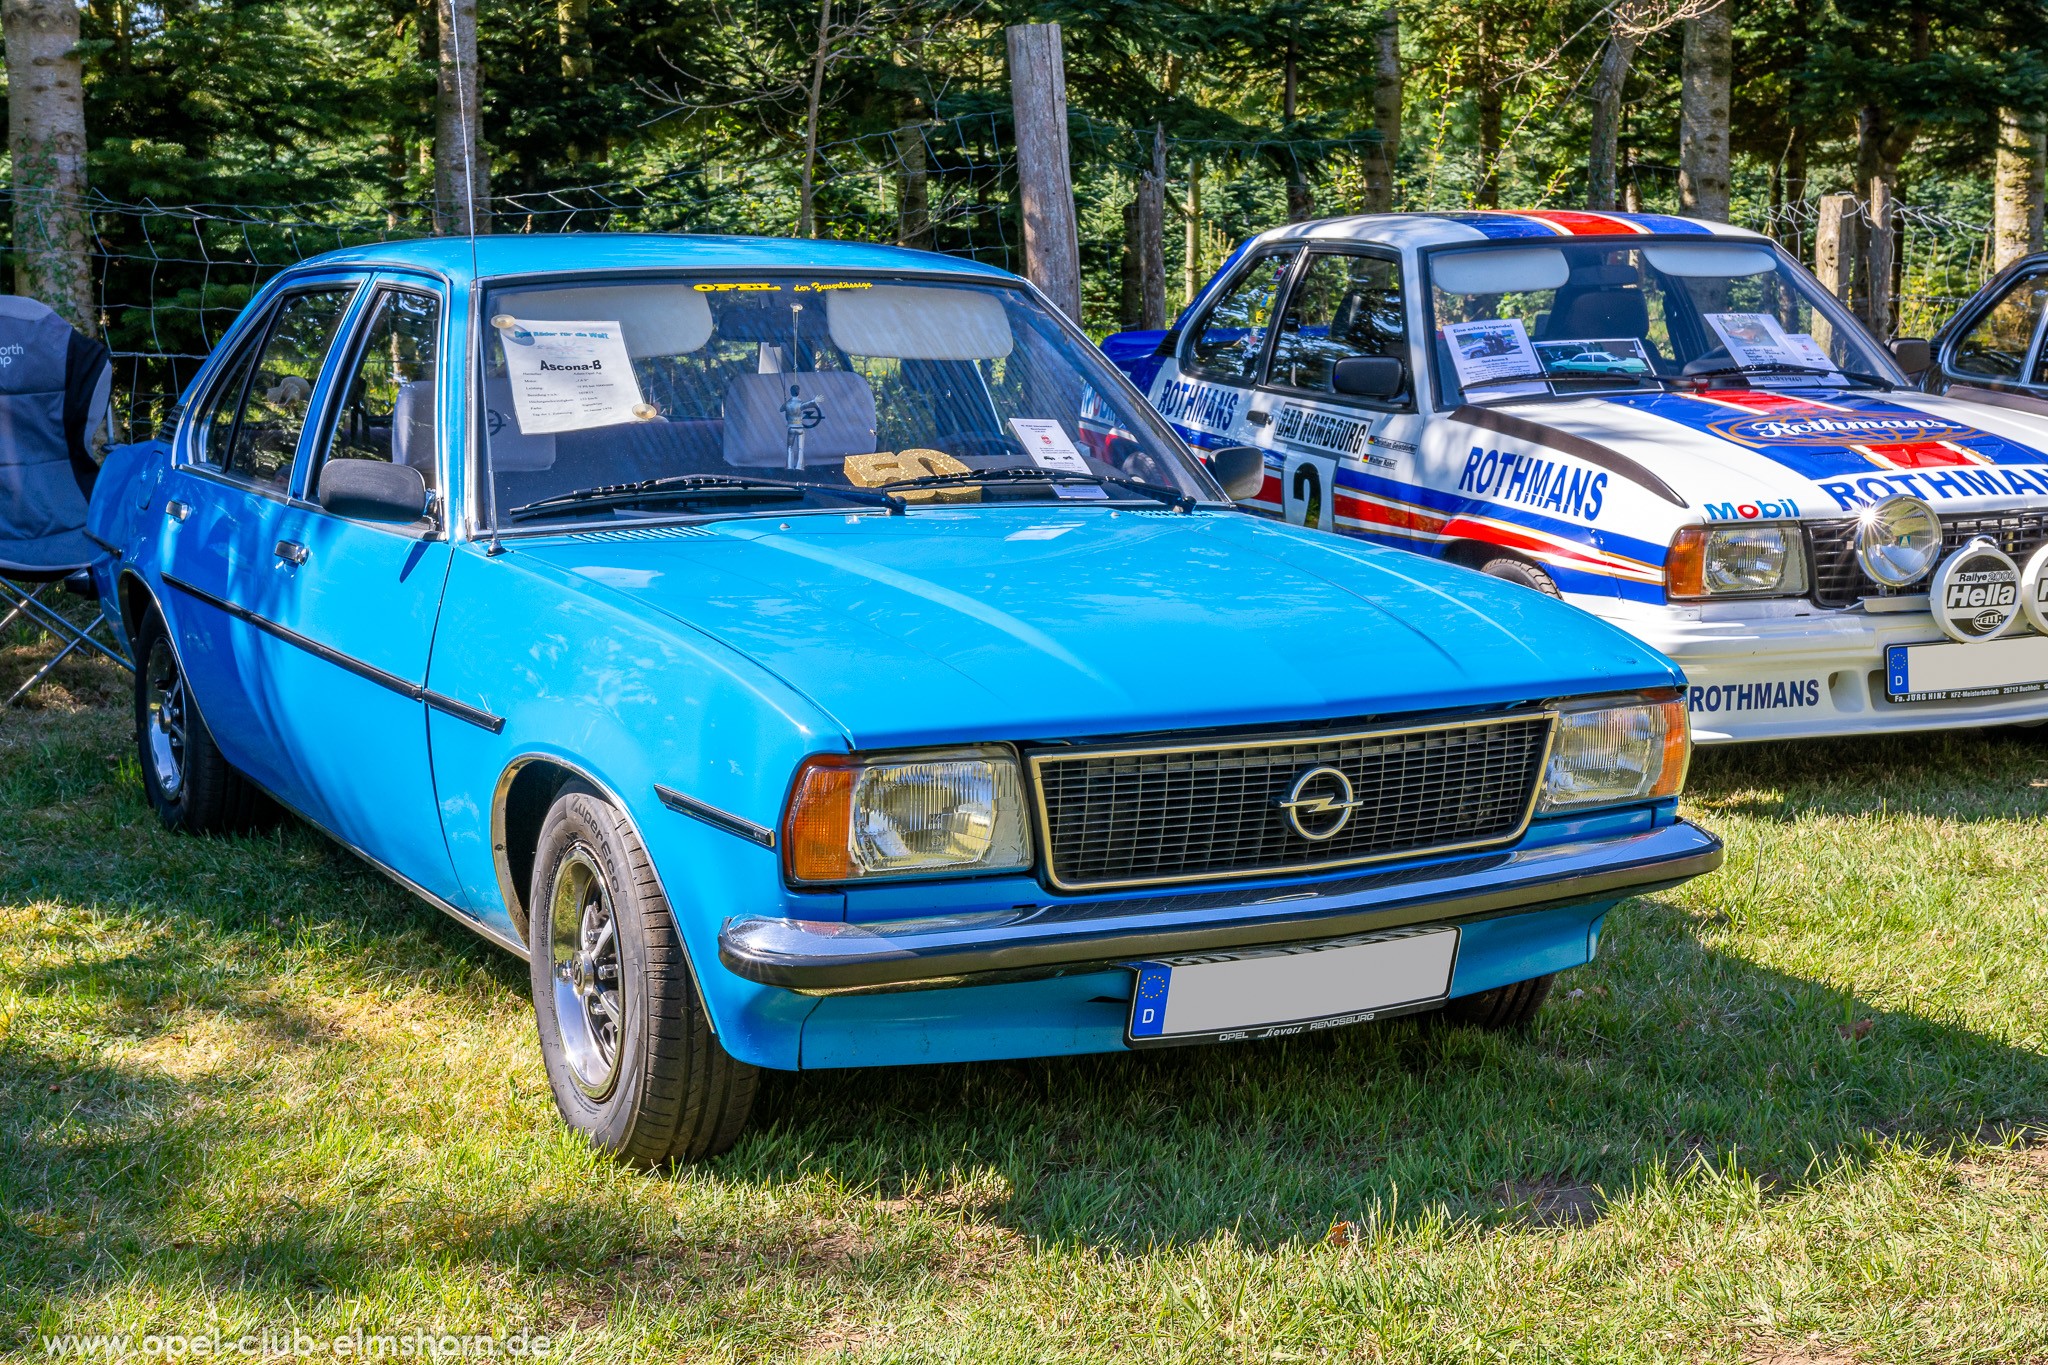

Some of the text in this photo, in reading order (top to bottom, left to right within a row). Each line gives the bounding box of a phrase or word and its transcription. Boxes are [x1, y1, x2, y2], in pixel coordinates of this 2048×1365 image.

[693, 283, 781, 292] OPEL
[540, 359, 602, 371] Ascona-B
[1158, 379, 1239, 431] ROTHMANS
[1277, 408, 1367, 454] BAD HOMBOURG
[1751, 418, 1962, 437] Rothmans
[1369, 456, 1383, 464] Walter
[1458, 446, 1608, 522] ROTHMANS
[1703, 499, 1800, 520] Mobil
[1959, 570, 2016, 583] Rallye 2000
[1947, 583, 2015, 608] Hella
[1975, 614, 2003, 624] HELLA
[1895, 675, 1903, 686] D
[1689, 679, 1819, 712] ROTHMANS
[1894, 695, 1905, 703] Fa.
[1928, 692, 1947, 700] HINZ
[1951, 688, 2000, 698] KFZ-Meisterbetrieb
[2019, 683, 2041, 693] Buchholz
[1142, 1008, 1154, 1024] D
[1219, 1031, 1249, 1041] OPEL
[1310, 1012, 1375, 1030] RENDSBURG
